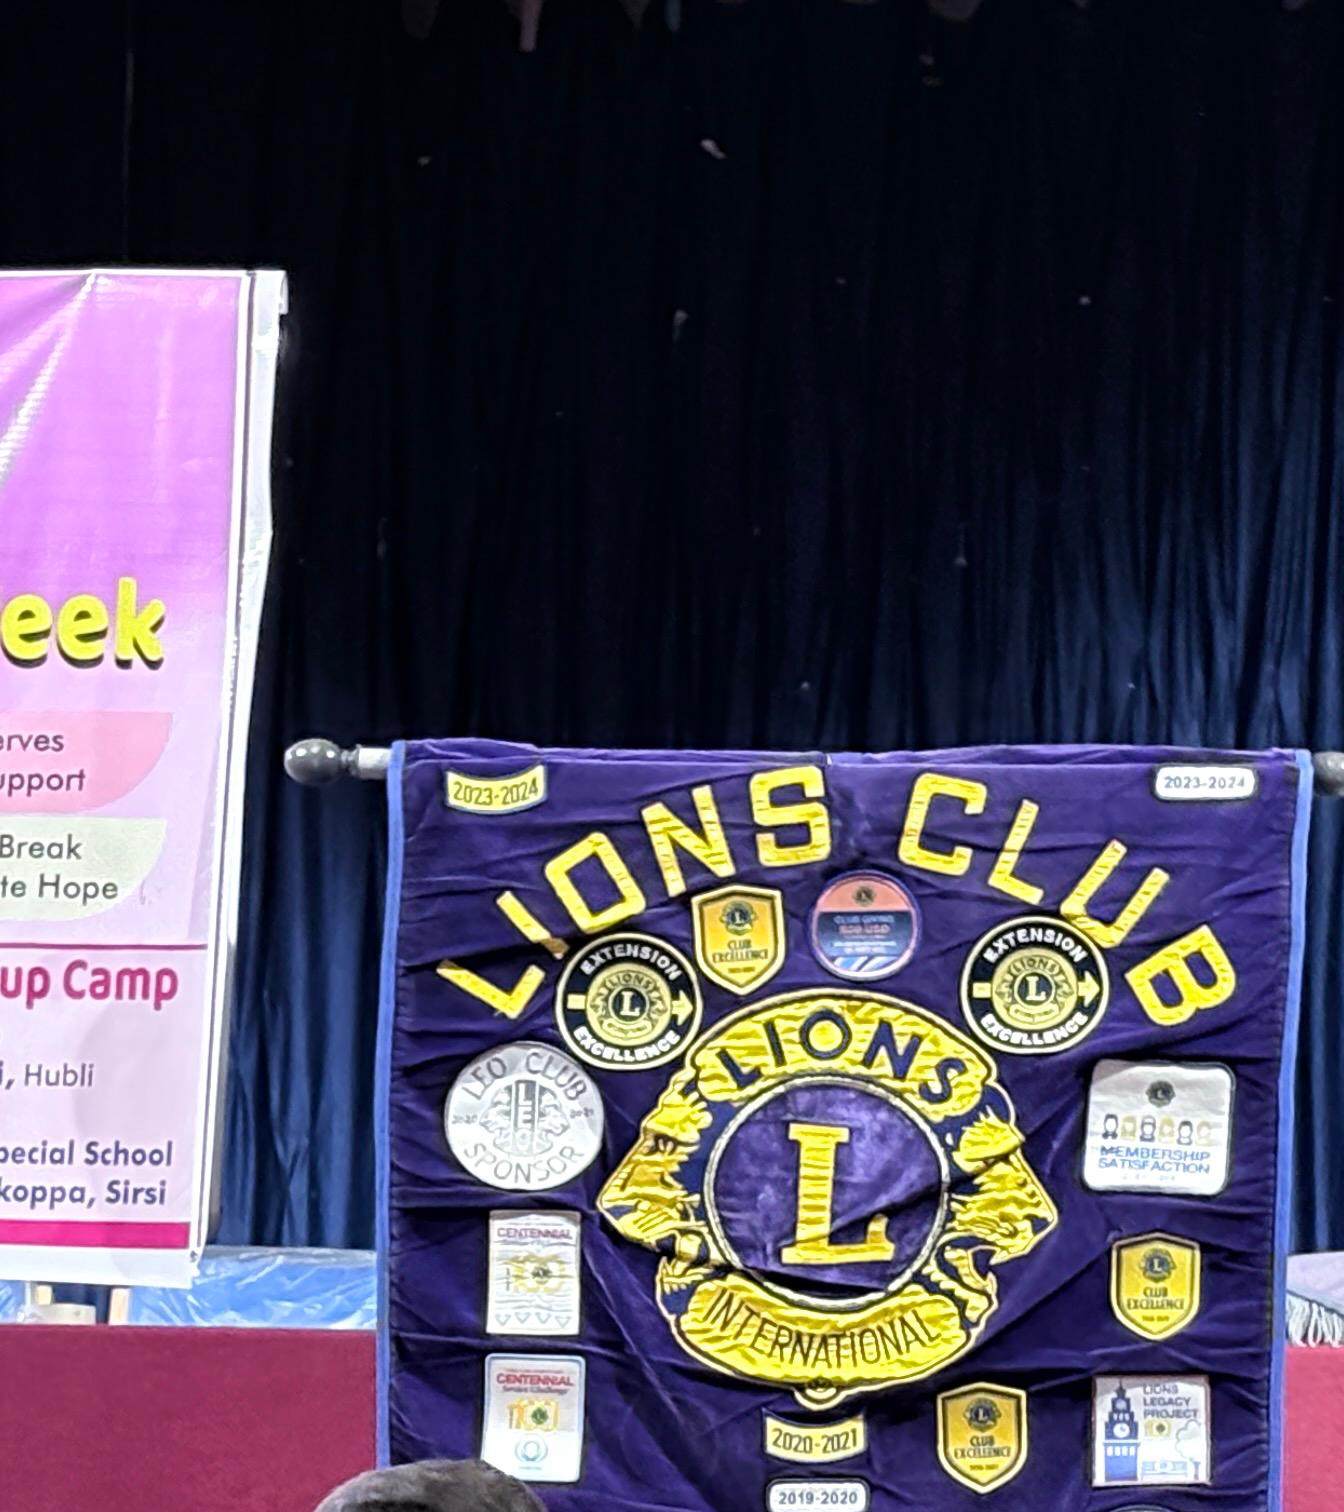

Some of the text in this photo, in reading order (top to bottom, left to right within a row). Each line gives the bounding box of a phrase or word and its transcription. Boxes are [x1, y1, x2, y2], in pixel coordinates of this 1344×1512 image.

[452, 776, 539, 806] 2023-2024
[1164, 775, 1246, 791] 2023-2024
[37, 874, 119, 905] Hope
[435, 765, 1237, 1027] LIONS CLUB
[983, 927, 1088, 963] EXTENSION
[580, 944, 684, 980] EXTENSION
[62, 959, 180, 1011] Camp
[980, 1011, 1089, 1046] EXCELLENCE
[573, 1025, 681, 1062] EXCELLENCE
[715, 1009, 968, 1104] LIONS
[23, 1062, 95, 1088] Hubli
[461, 1050, 587, 1101] LEO CLUB
[83, 1140, 174, 1167] School
[463, 1142, 585, 1184] SPONSOR
[1098, 1157, 1211, 1174] SATISFACTION
[1100, 1145, 1211, 1162] MEMBERSHIP
[104, 1179, 167, 1206] Sirsi
[782, 1122, 896, 1265] L
[497, 1227, 573, 1240] CENTENNIAL
[1127, 1298, 1184, 1310] EXCELLENCE
[1143, 1286, 1168, 1298] CLUB
[702, 1287, 942, 1368] INTERNATIONAL
[496, 1373, 574, 1387] CENTENNIAL
[1143, 1383, 1179, 1395] LIONS
[1143, 1396, 1191, 1407] LEGACY
[1143, 1408, 1199, 1419] PROJECT
[771, 1427, 857, 1454] 2020-2021
[778, 1491, 858, 1505] 2019-2020
